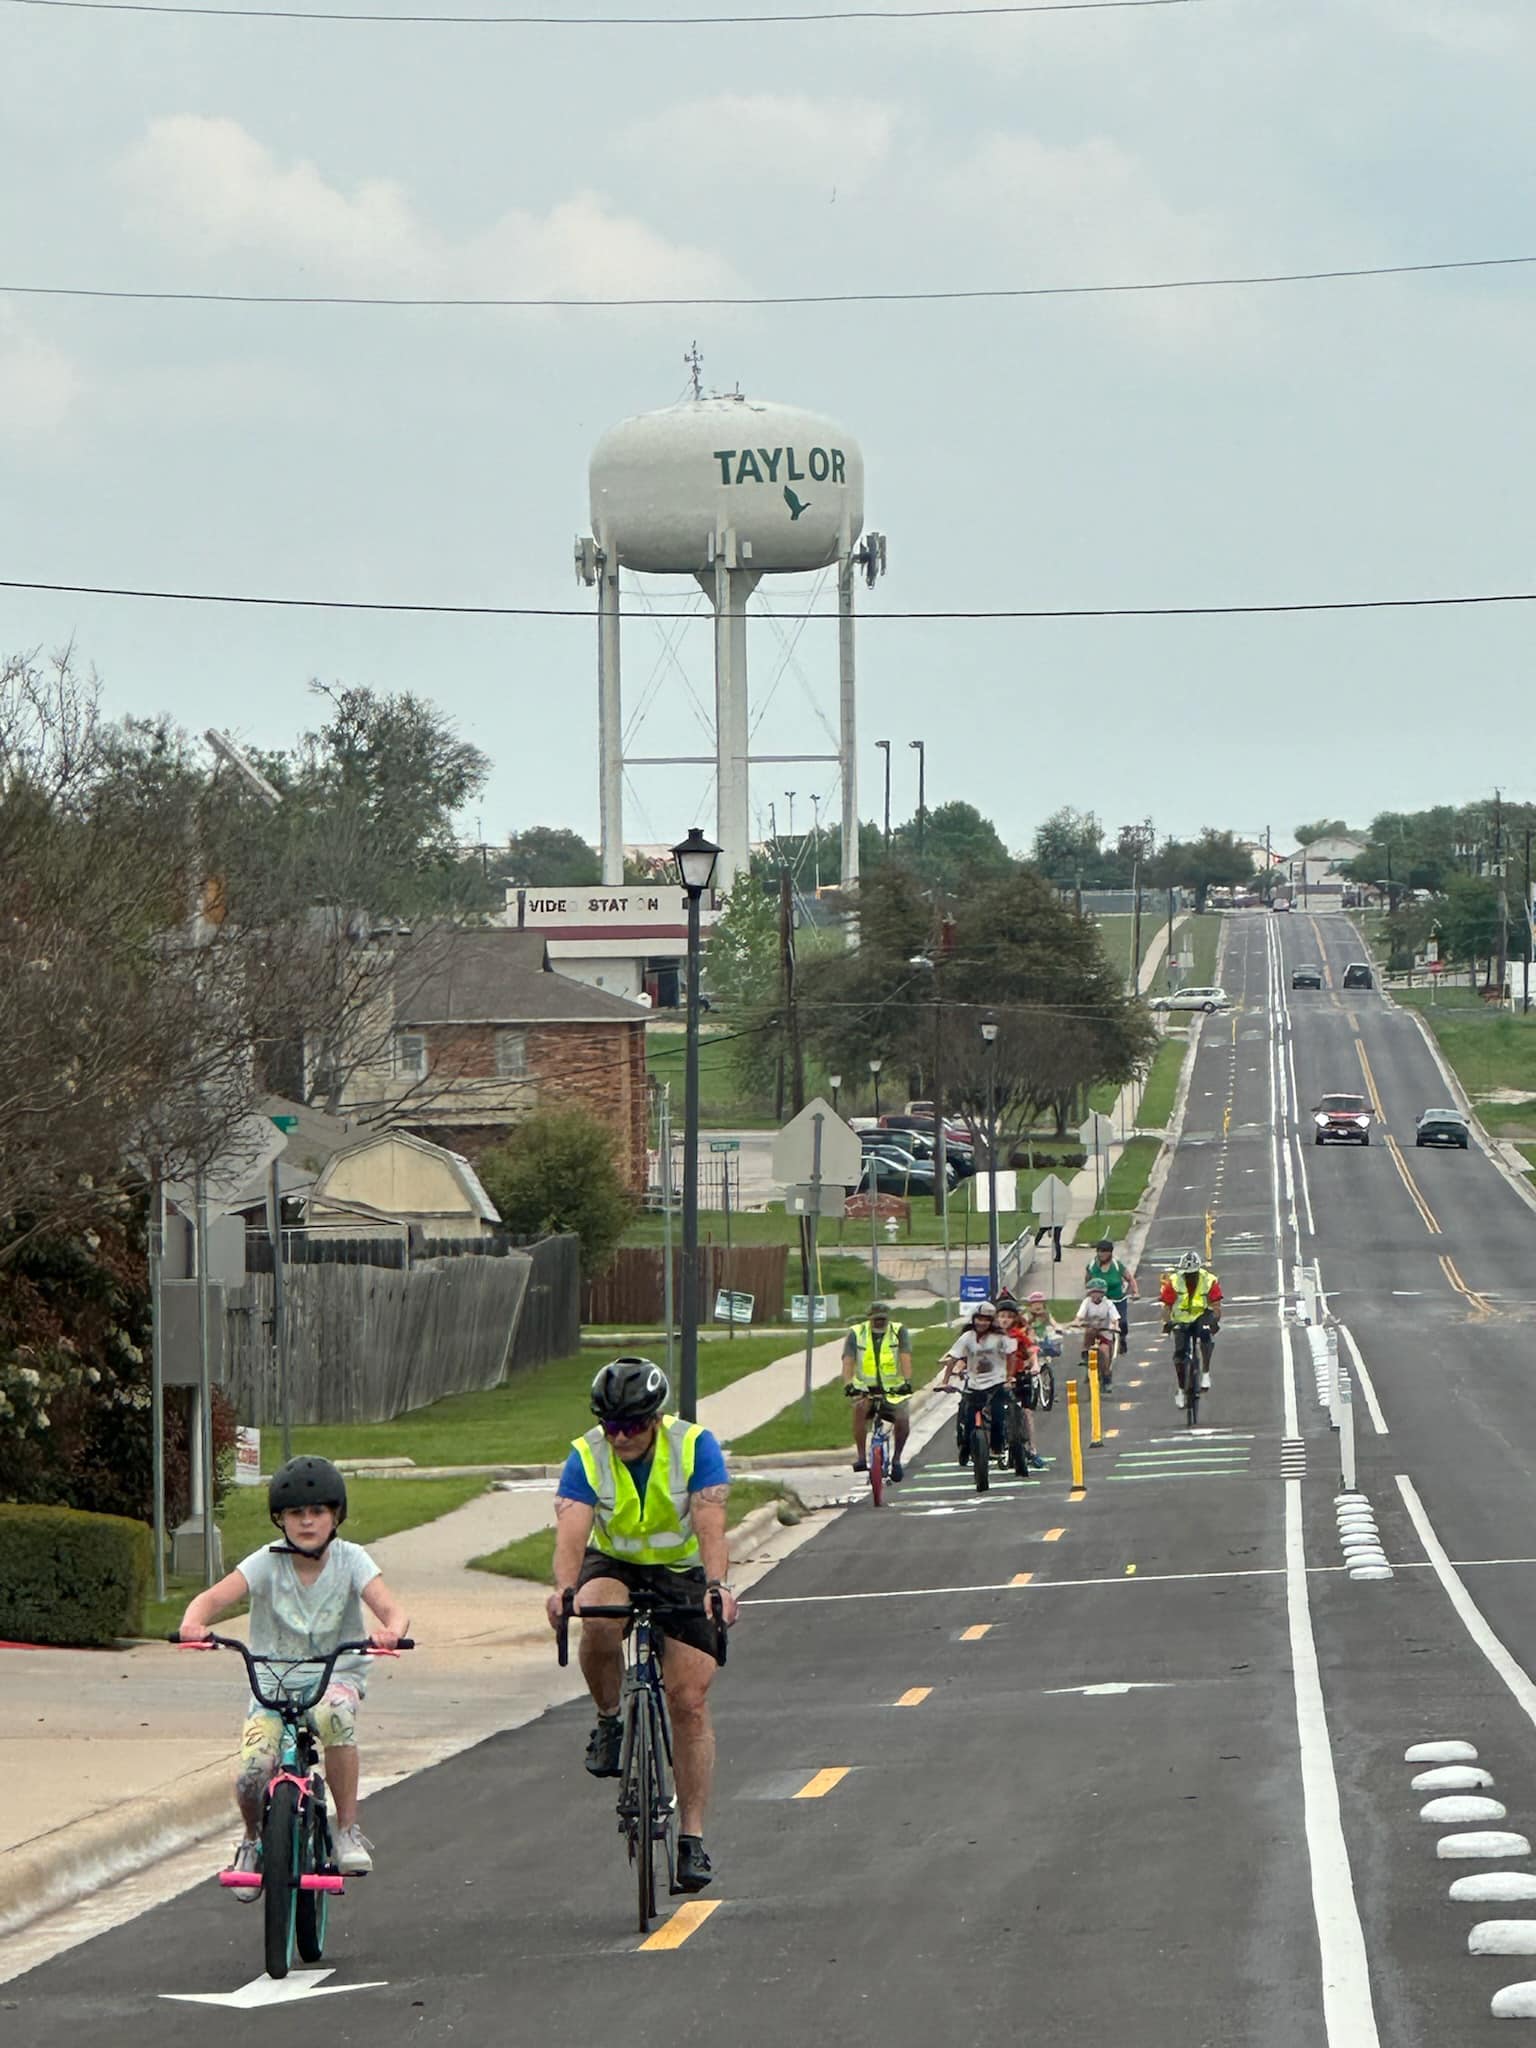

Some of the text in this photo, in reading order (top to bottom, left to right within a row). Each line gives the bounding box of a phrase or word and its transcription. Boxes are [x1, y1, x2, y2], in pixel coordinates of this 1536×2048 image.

[713, 447, 846, 485] TAYLOR
[528, 897, 659, 913] VIDE STATN
